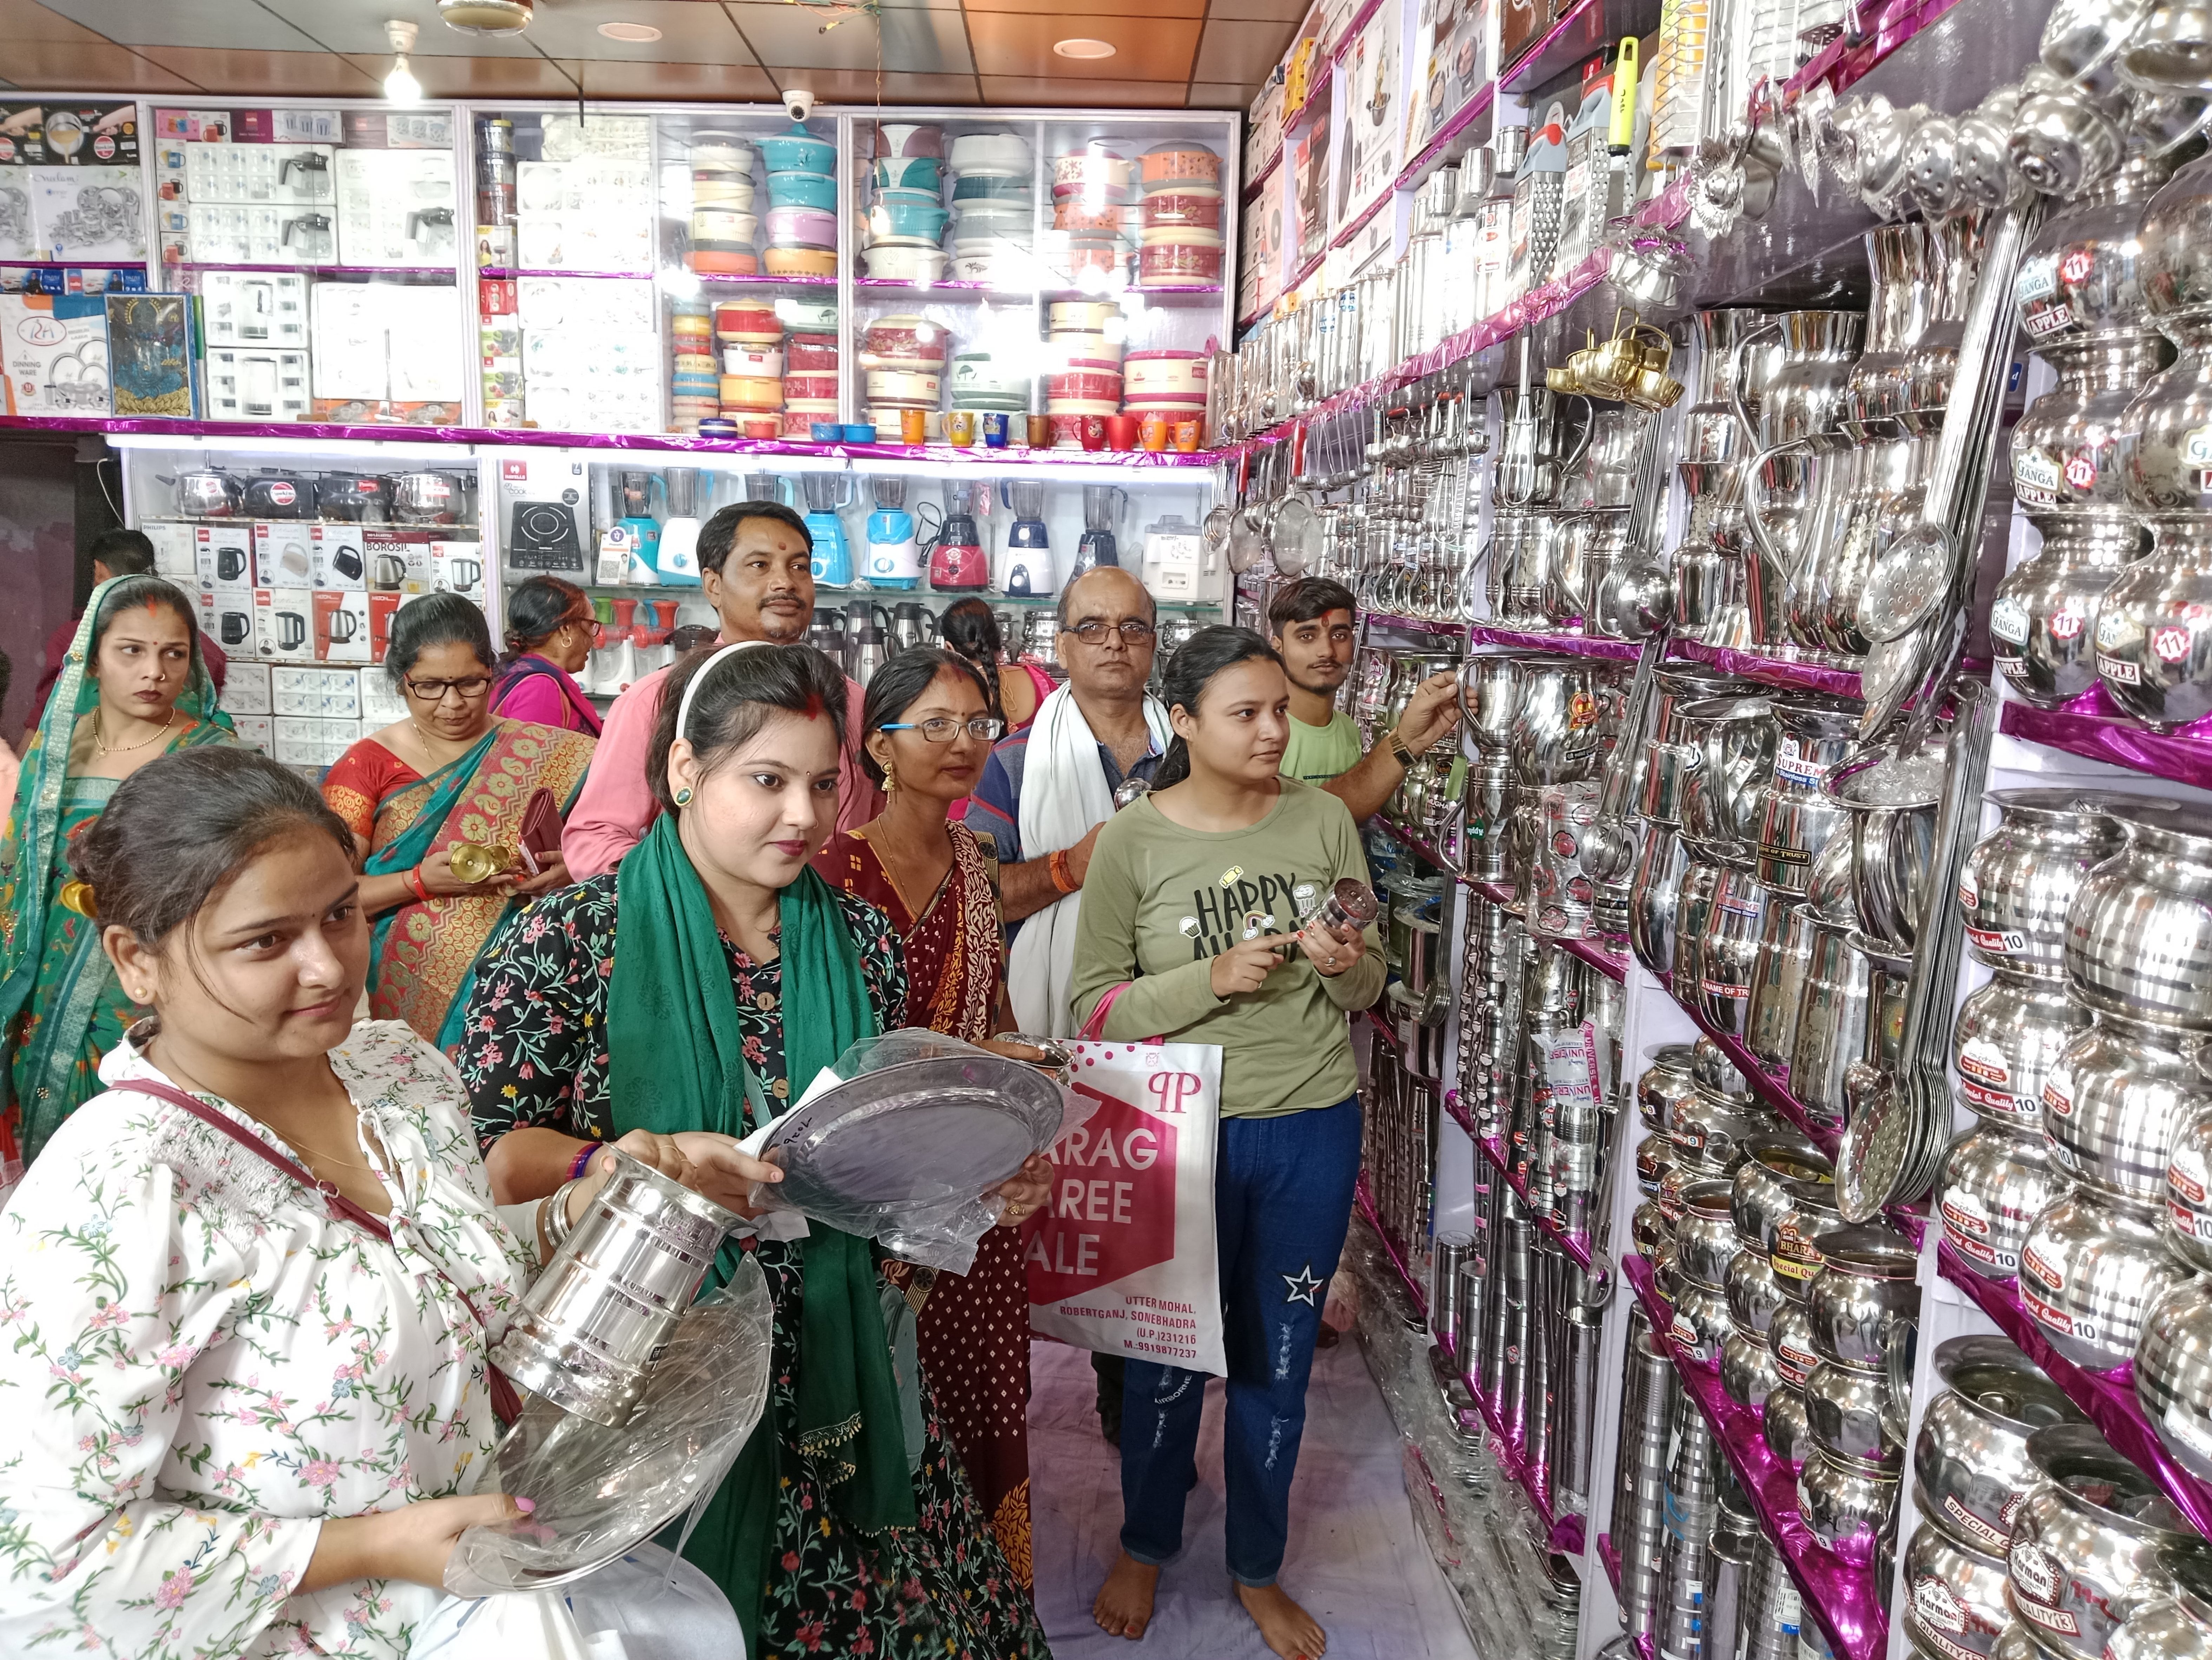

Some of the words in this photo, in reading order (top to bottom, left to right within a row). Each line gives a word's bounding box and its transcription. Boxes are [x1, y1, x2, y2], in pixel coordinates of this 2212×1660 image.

[2067, 257, 2083, 276] 11
[2019, 277, 2049, 298] GANGA
[2030, 308, 2069, 333] APPLE
[2017, 460, 2054, 486] GANGA
[2071, 464, 2086, 480] 11
[2019, 486, 2054, 503] APPLE
[366, 542, 410, 552] BOROSIL
[1993, 610, 2021, 637] GANGA
[2057, 615, 2073, 632] 11
[2161, 634, 2181, 654] 11
[2099, 657, 2135, 680] APPLE
[1777, 754, 1825, 777] SUPREM
[1779, 769, 1807, 783] Stainless
[1467, 827, 1484, 836] Apple
[1780, 850, 1807, 859] TRUST
[1194, 872, 1300, 938] HAPPY
[1718, 895, 1760, 912] SUPREME
[1980, 934, 2004, 950] Quality
[2004, 935, 2023, 949] 10
[1705, 982, 1724, 993] NAME
[1724, 987, 1735, 995] OF
[1585, 1037, 1597, 1080] UNIVERSE
[1648, 1105, 1653, 1113] 9
[1984, 1093, 2014, 1111] Quality
[2015, 1099, 2036, 1112] 10
[1689, 1137, 1696, 1146] 9
[2057, 1147, 2071, 1165] 10
[2171, 1206, 2193, 1233] Quality
[2195, 1218, 2212, 1239] 10
[1023, 1230, 1100, 1276] ALE
[1646, 1245, 1653, 1254] 9
[1965, 1242, 1994, 1262] Quality
[1996, 1253, 2016, 1267] 10
[1773, 1258, 1798, 1274] Special
[1126, 1296, 1156, 1308] UTTER
[1159, 1299, 1196, 1314] MOHAL,
[1060, 1306, 1128, 1320] ROBERTGANJ,
[1131, 1311, 1196, 1329] SONEBHADRA
[2041, 1308, 2072, 1333] Quality
[2074, 1322, 2095, 1339] 10
[1947, 1501, 1996, 1542] SPECIAL
[1819, 1537, 1827, 1547] 9
[2014, 1551, 2047, 1587] Harman
[1920, 1592, 1957, 1622] Harman
[2055, 1614, 2073, 1630] 13
[1920, 1621, 1964, 1658] QUALITY
